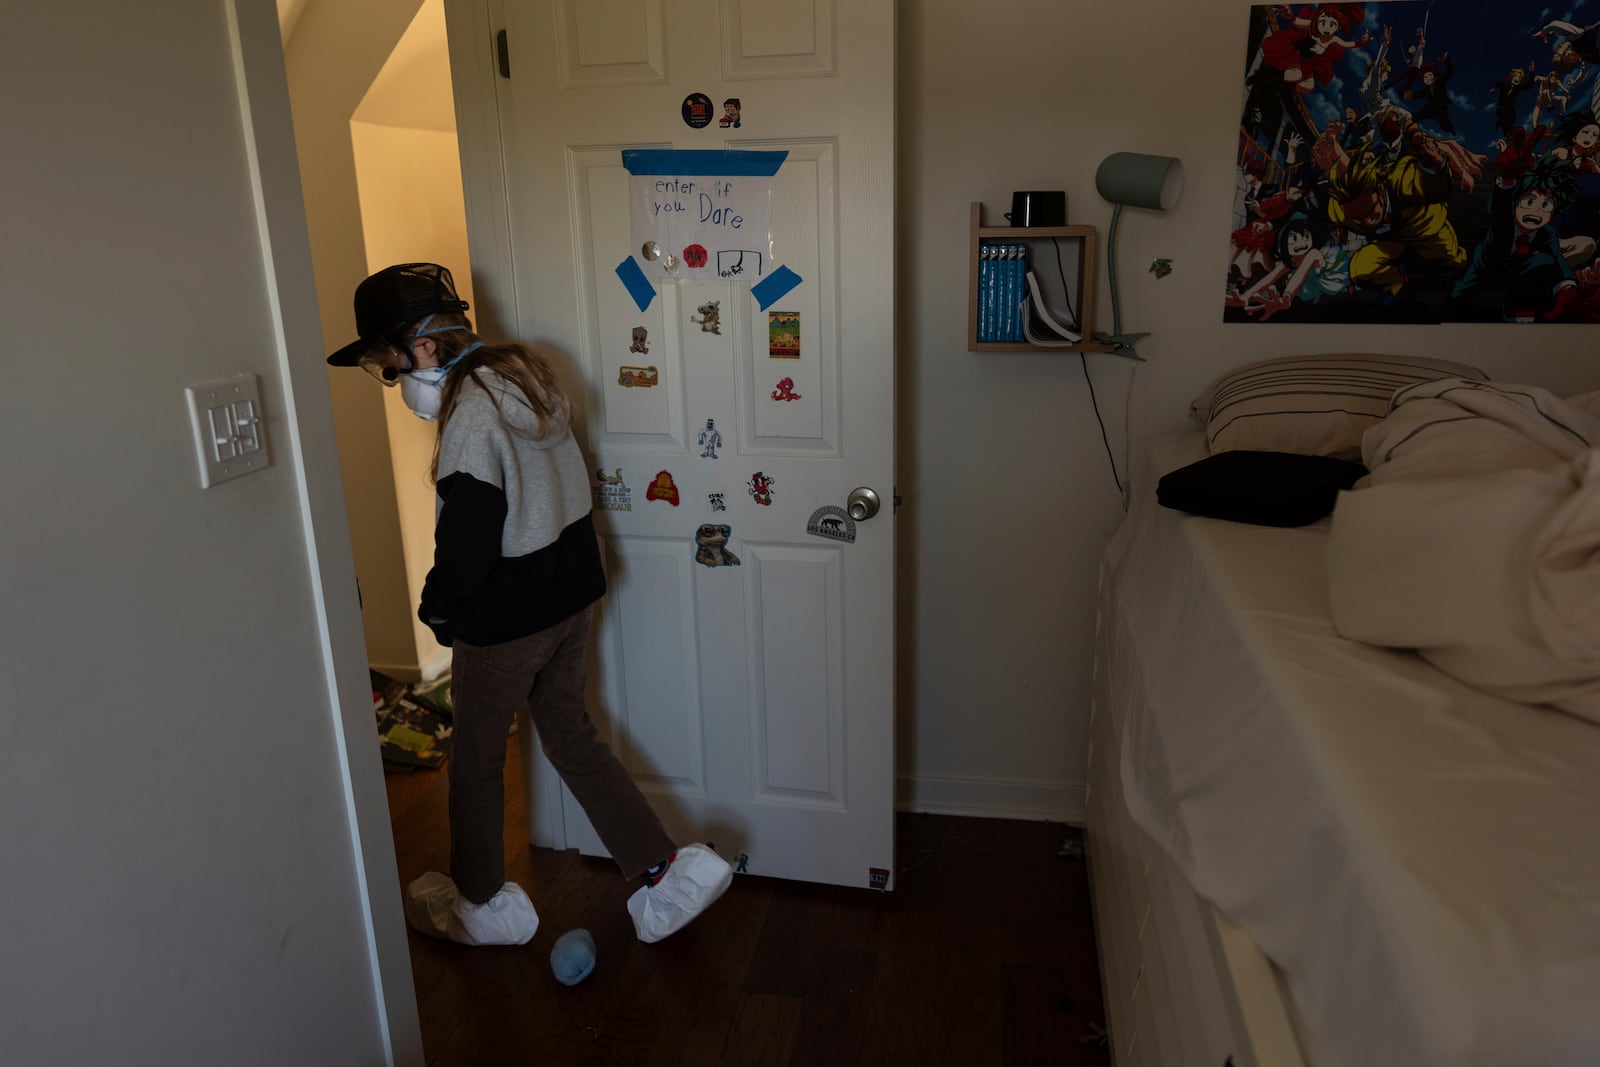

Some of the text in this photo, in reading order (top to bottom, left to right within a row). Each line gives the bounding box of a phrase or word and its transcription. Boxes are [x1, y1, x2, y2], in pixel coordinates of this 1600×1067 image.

[655, 178, 733, 198] enter if
[654, 192, 744, 229] you Dare
